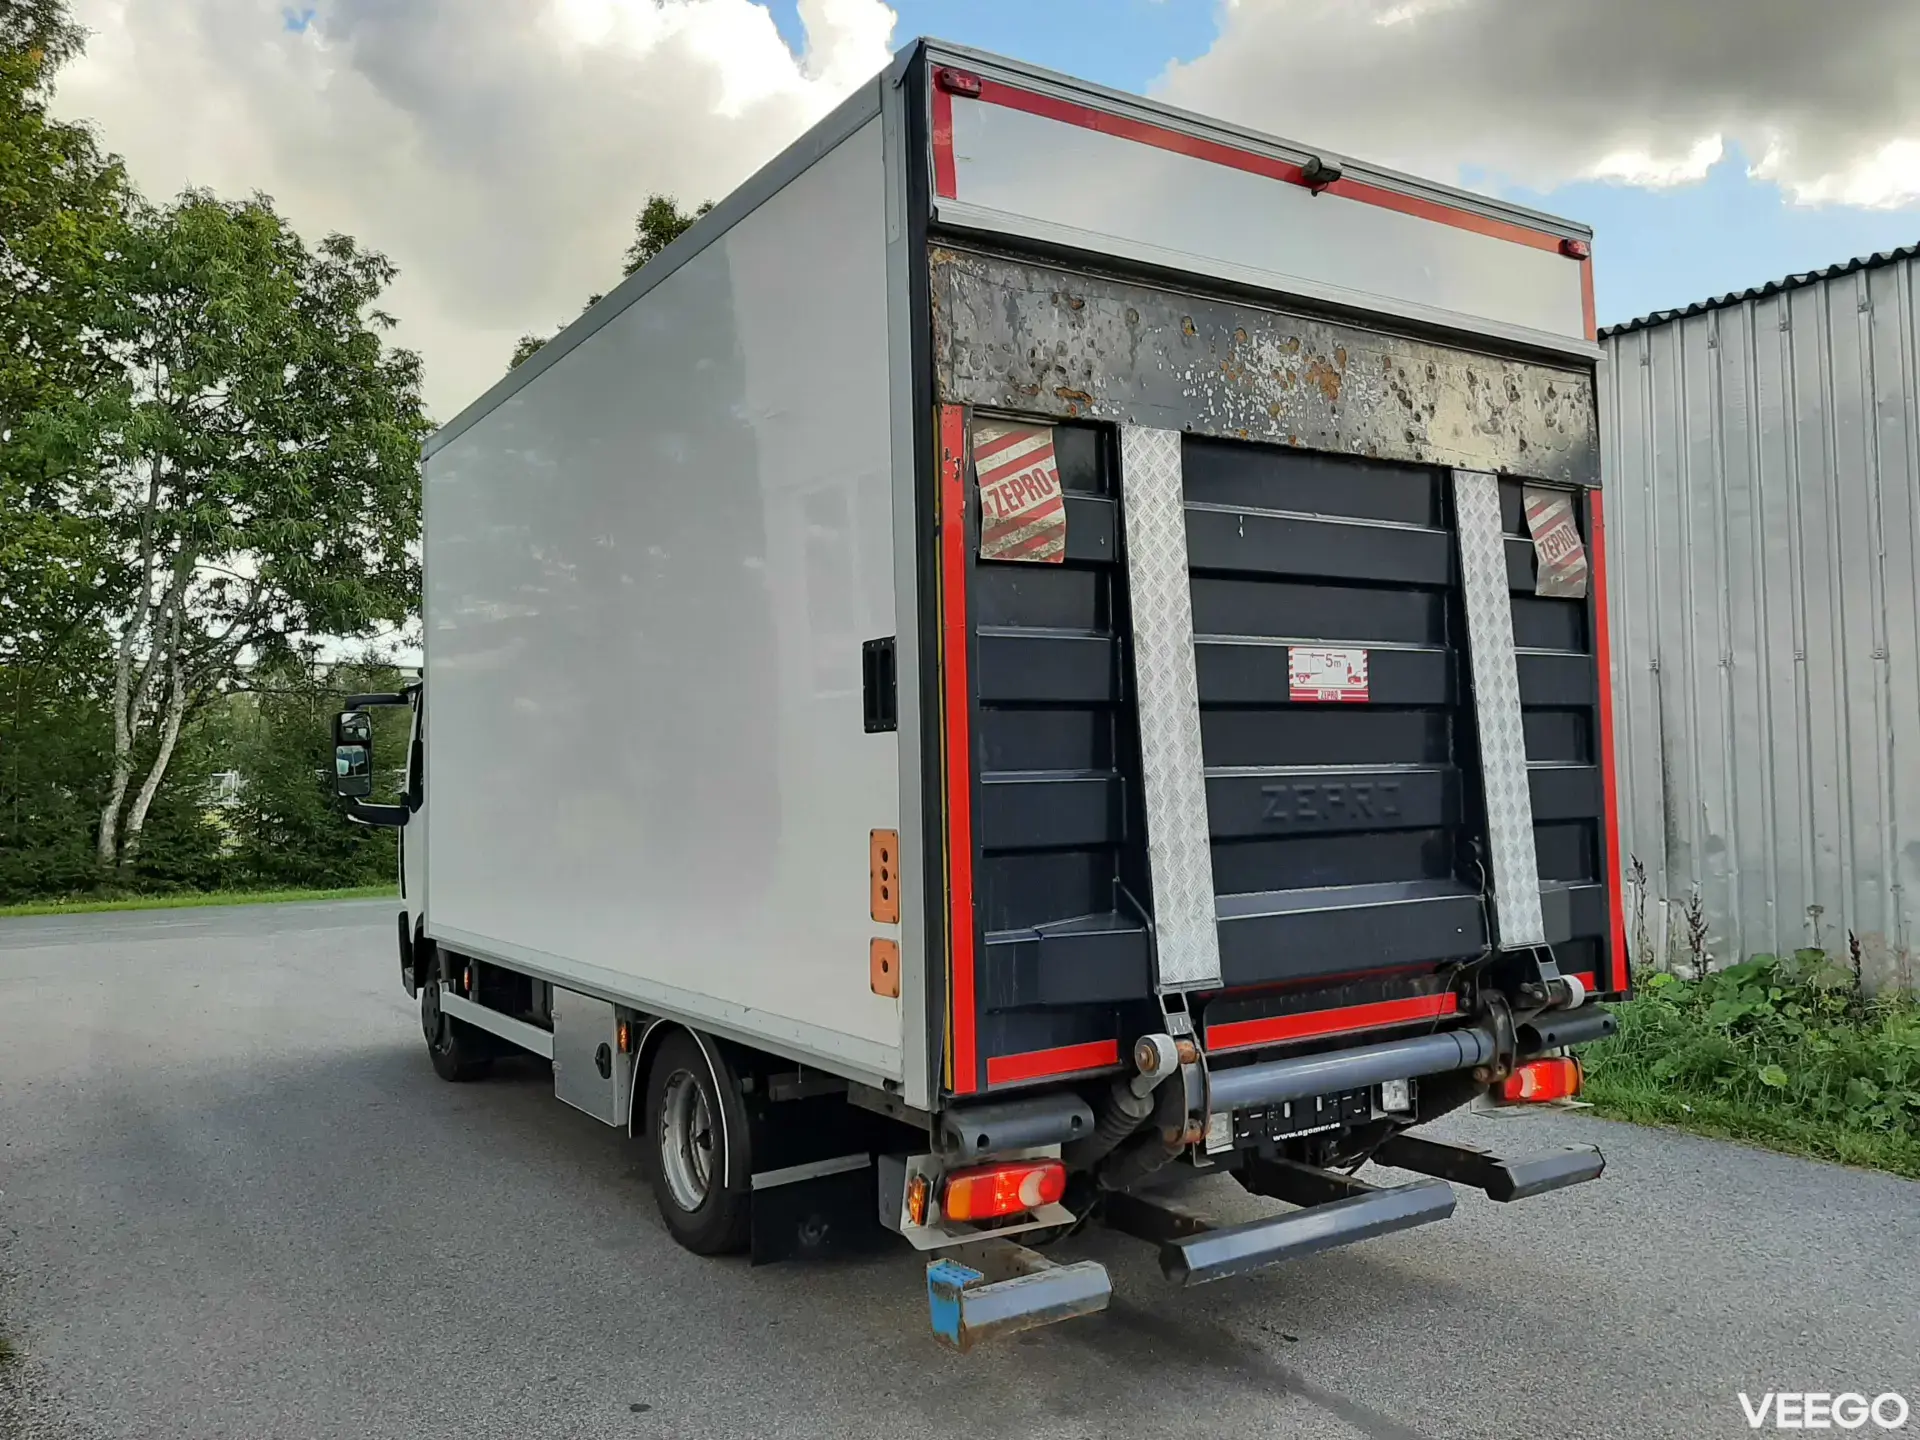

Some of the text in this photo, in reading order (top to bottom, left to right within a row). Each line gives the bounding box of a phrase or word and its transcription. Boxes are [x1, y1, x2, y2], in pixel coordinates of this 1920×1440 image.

[987, 468, 1054, 518] ZEPRO
[1538, 524, 1577, 562] ZEPRO
[1320, 690, 1339, 700] ZEPRO
